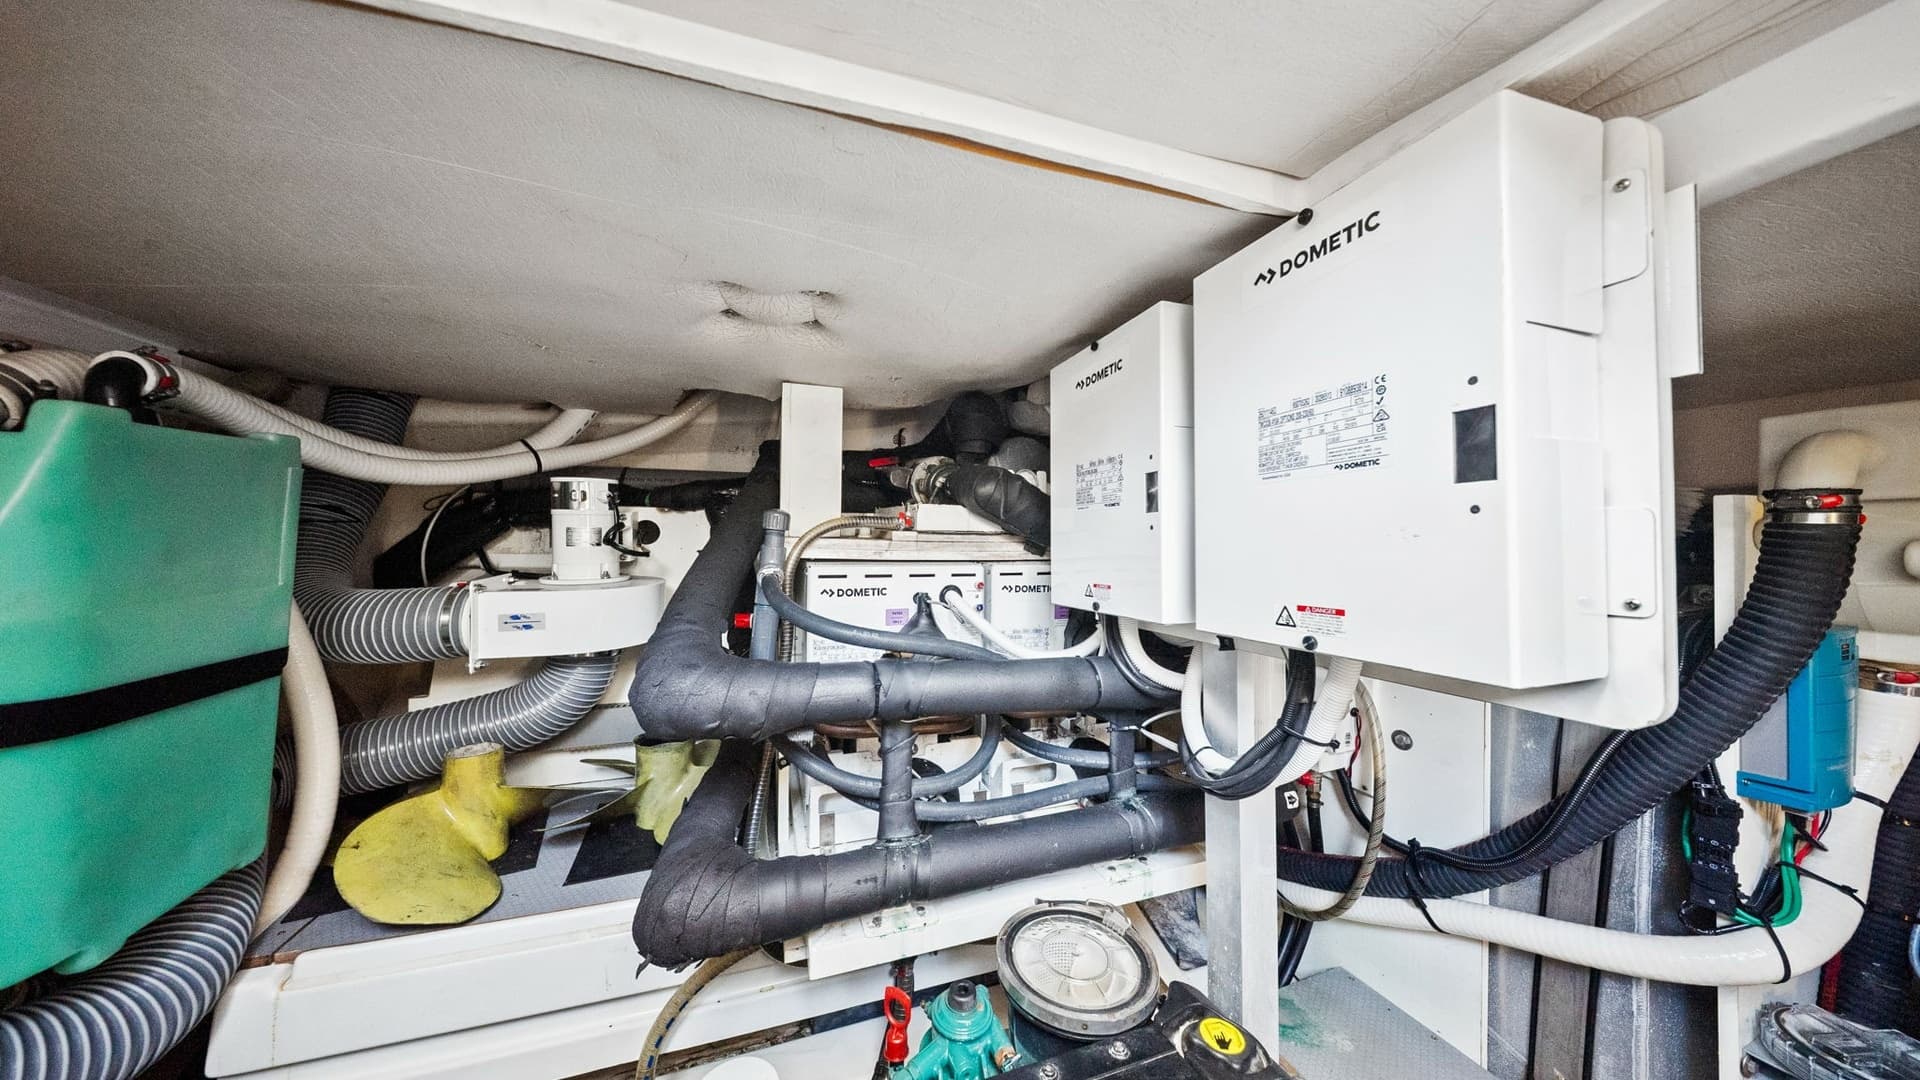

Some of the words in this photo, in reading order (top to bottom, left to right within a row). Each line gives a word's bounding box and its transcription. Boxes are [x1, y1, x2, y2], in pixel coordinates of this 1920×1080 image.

[1280, 211, 1380, 278] DOMETIC
[1085, 359, 1122, 387] DOMETIC
[1344, 458, 1380, 469] DOMETIC
[837, 587, 887, 597] DOMETIC
[1014, 584, 1051, 593] DOMETI
